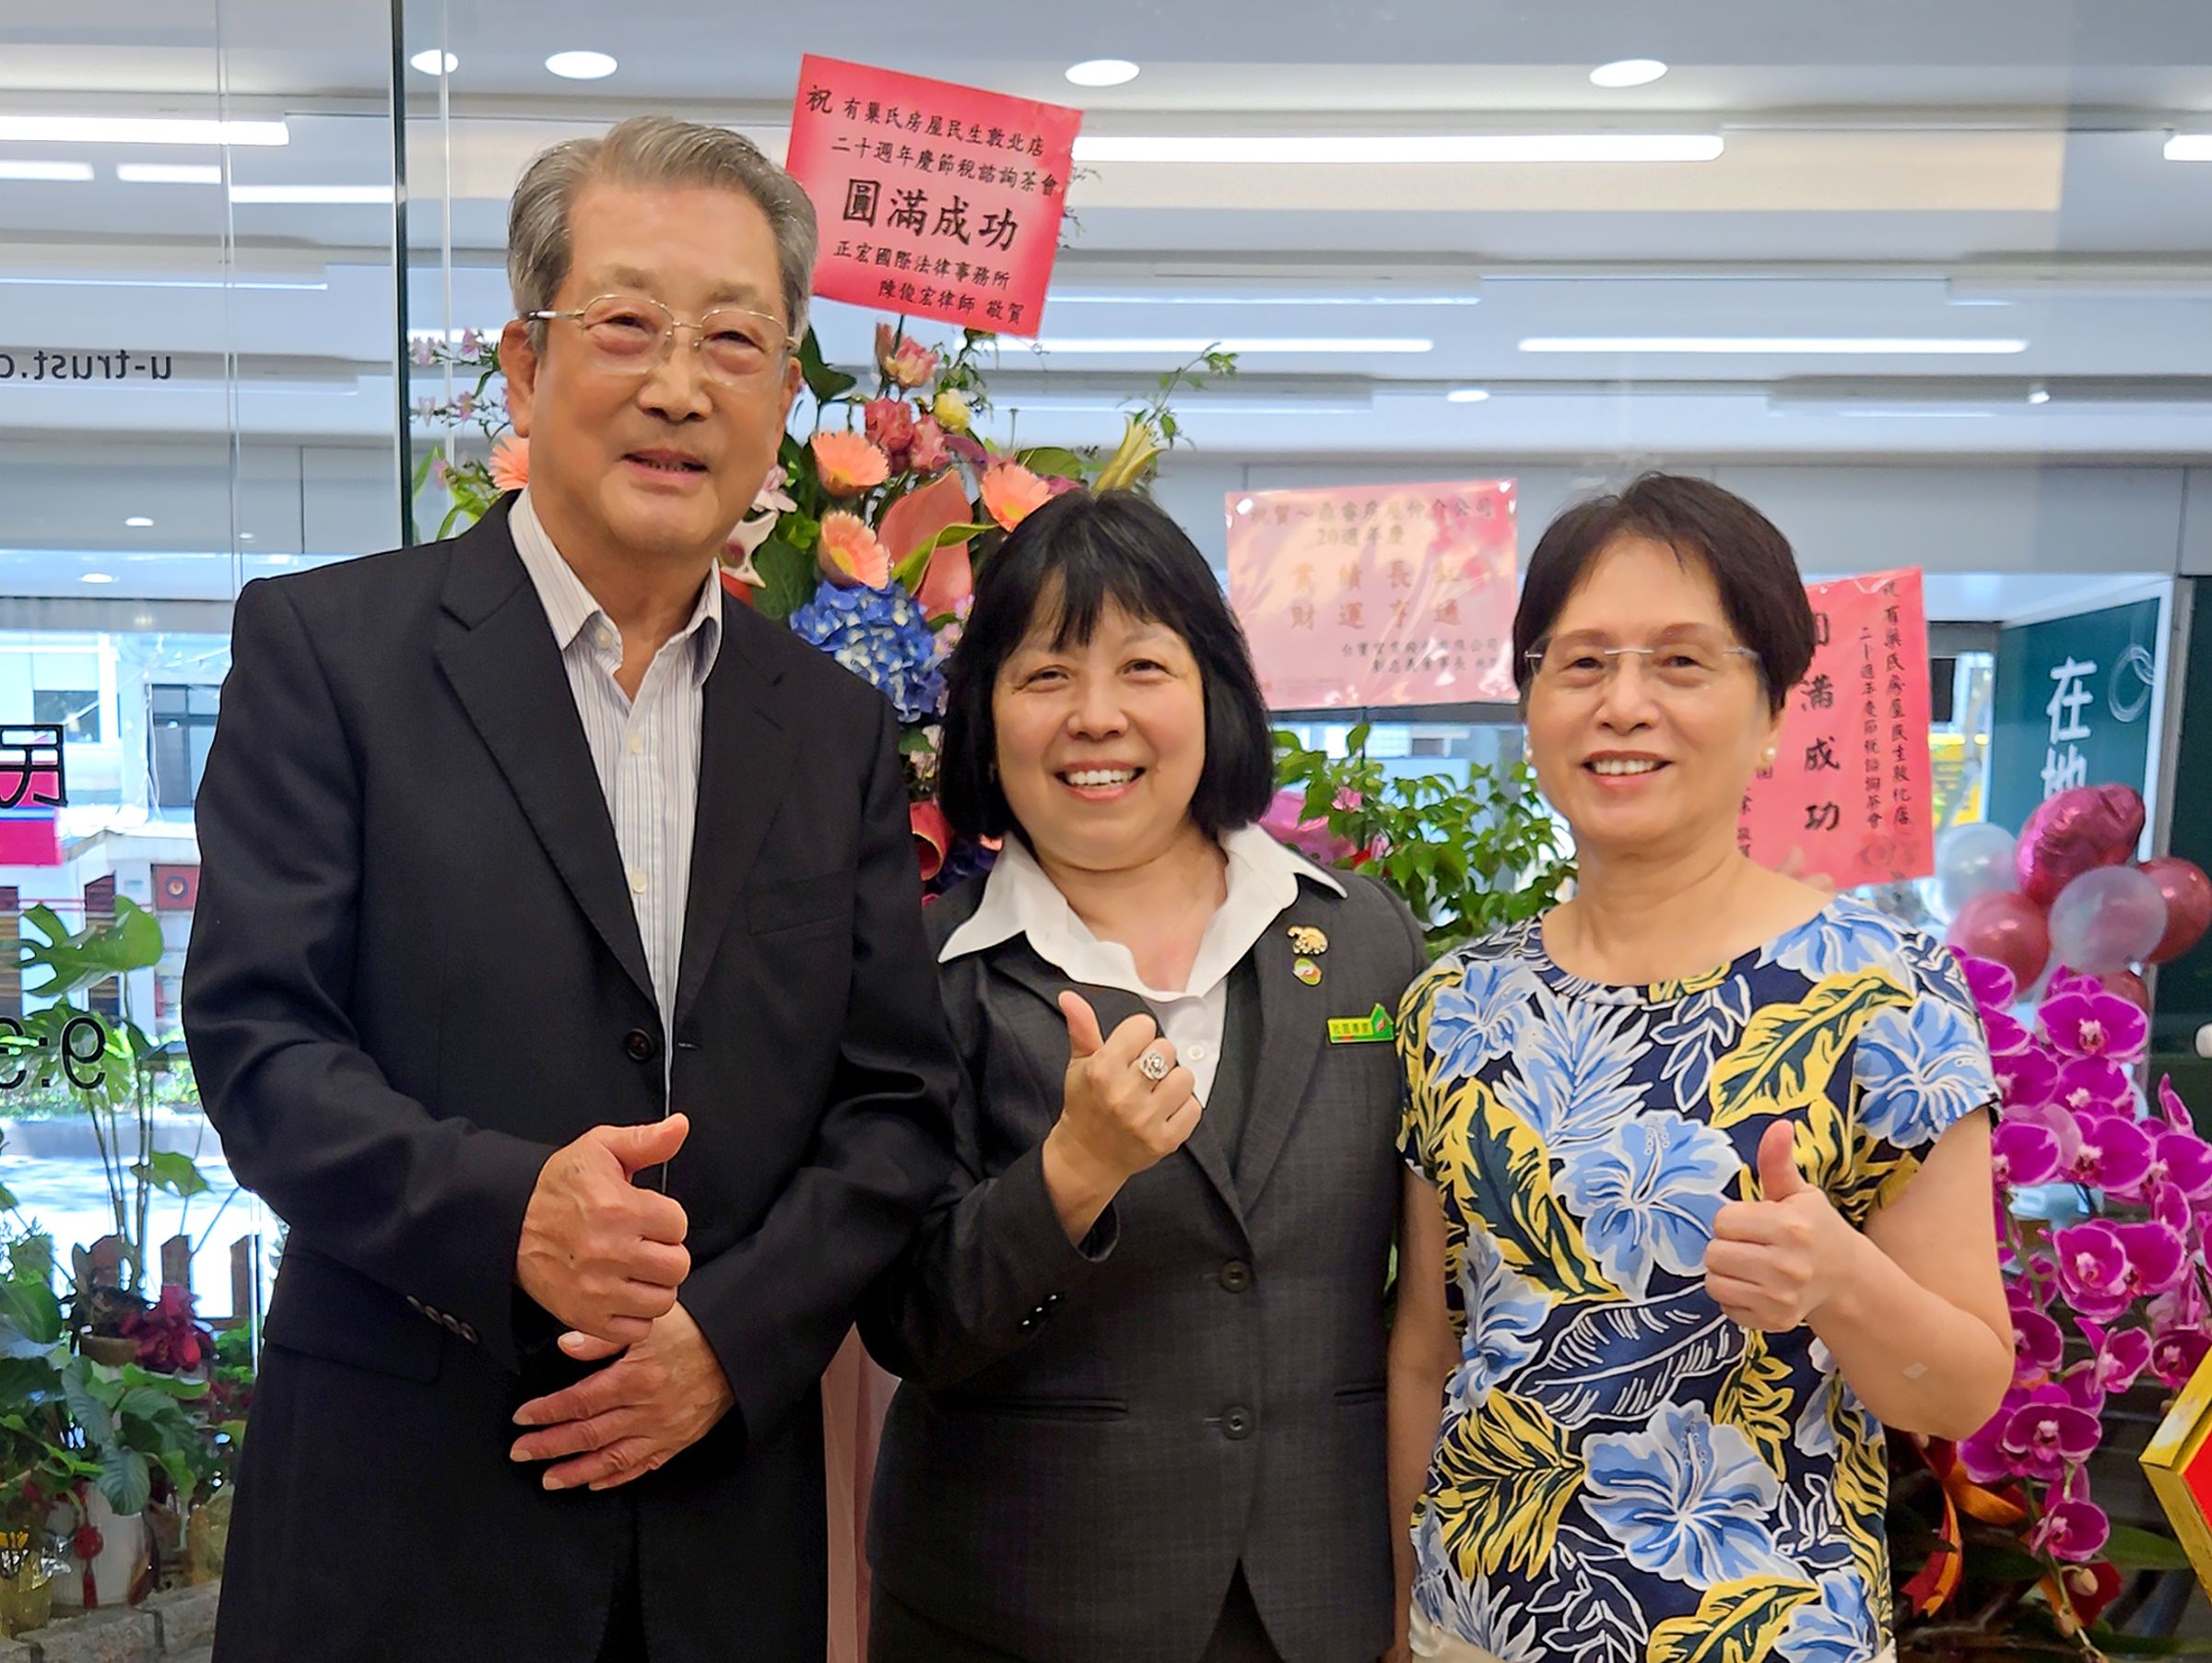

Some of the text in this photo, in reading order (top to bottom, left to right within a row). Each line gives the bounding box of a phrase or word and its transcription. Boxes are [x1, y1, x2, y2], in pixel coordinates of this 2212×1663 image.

[806, 84, 1045, 157] 祝 有巢氏房屋民生敦北店
[830, 136, 1060, 196] 二十週年慶節稅諮詢茶會
[842, 178, 1019, 252] 圓滿成功
[833, 240, 1012, 291] 正宏國際法律事務所
[985, 299, 1025, 325] 敬賀
